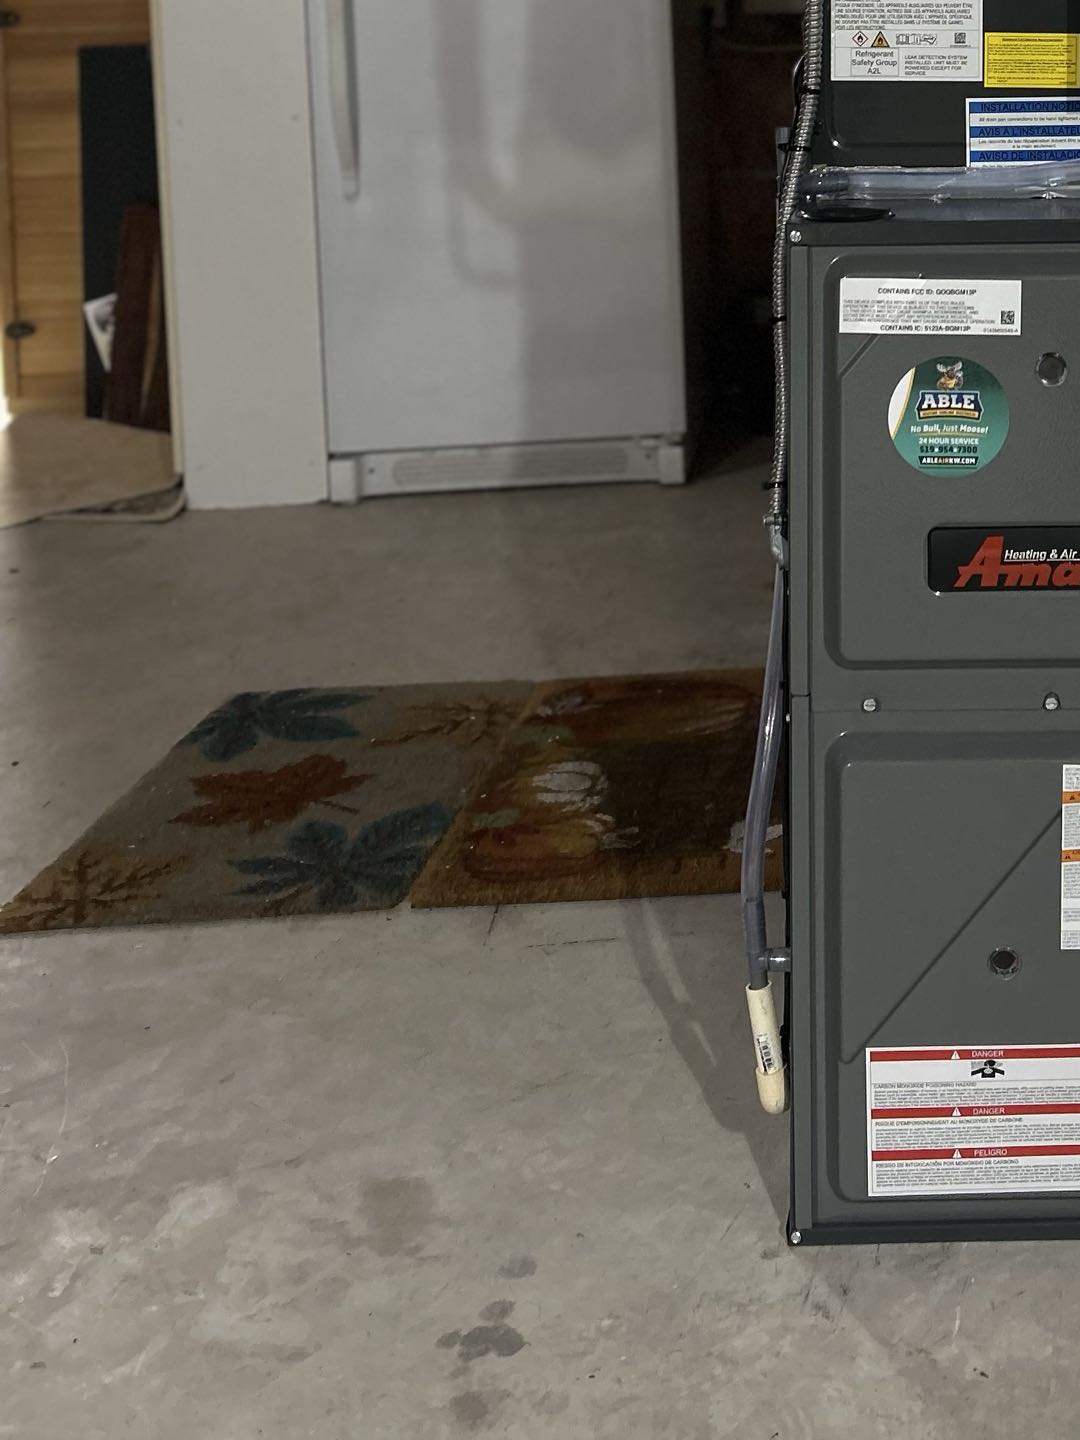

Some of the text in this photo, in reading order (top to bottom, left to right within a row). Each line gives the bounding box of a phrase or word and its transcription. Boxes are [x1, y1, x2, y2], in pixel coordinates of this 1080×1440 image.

[856, 51, 894, 59] Refrigerant
[981, 102, 1048, 111] INSTALLATION
[979, 127, 1000, 136] AVIS
[979, 151, 1025, 160] AVISO DE
[921, 394, 975, 409] ABLE
[910, 425, 922, 433] No
[942, 425, 958, 433] Just
[960, 424, 989, 434] Moose!
[1004, 549, 1047, 560] Heating
[1050, 550, 1059, 559] &
[1060, 549, 1078, 559] Air
[971, 1050, 1004, 1058] DANGER
[974, 1148, 1008, 1156] PELIGRO
